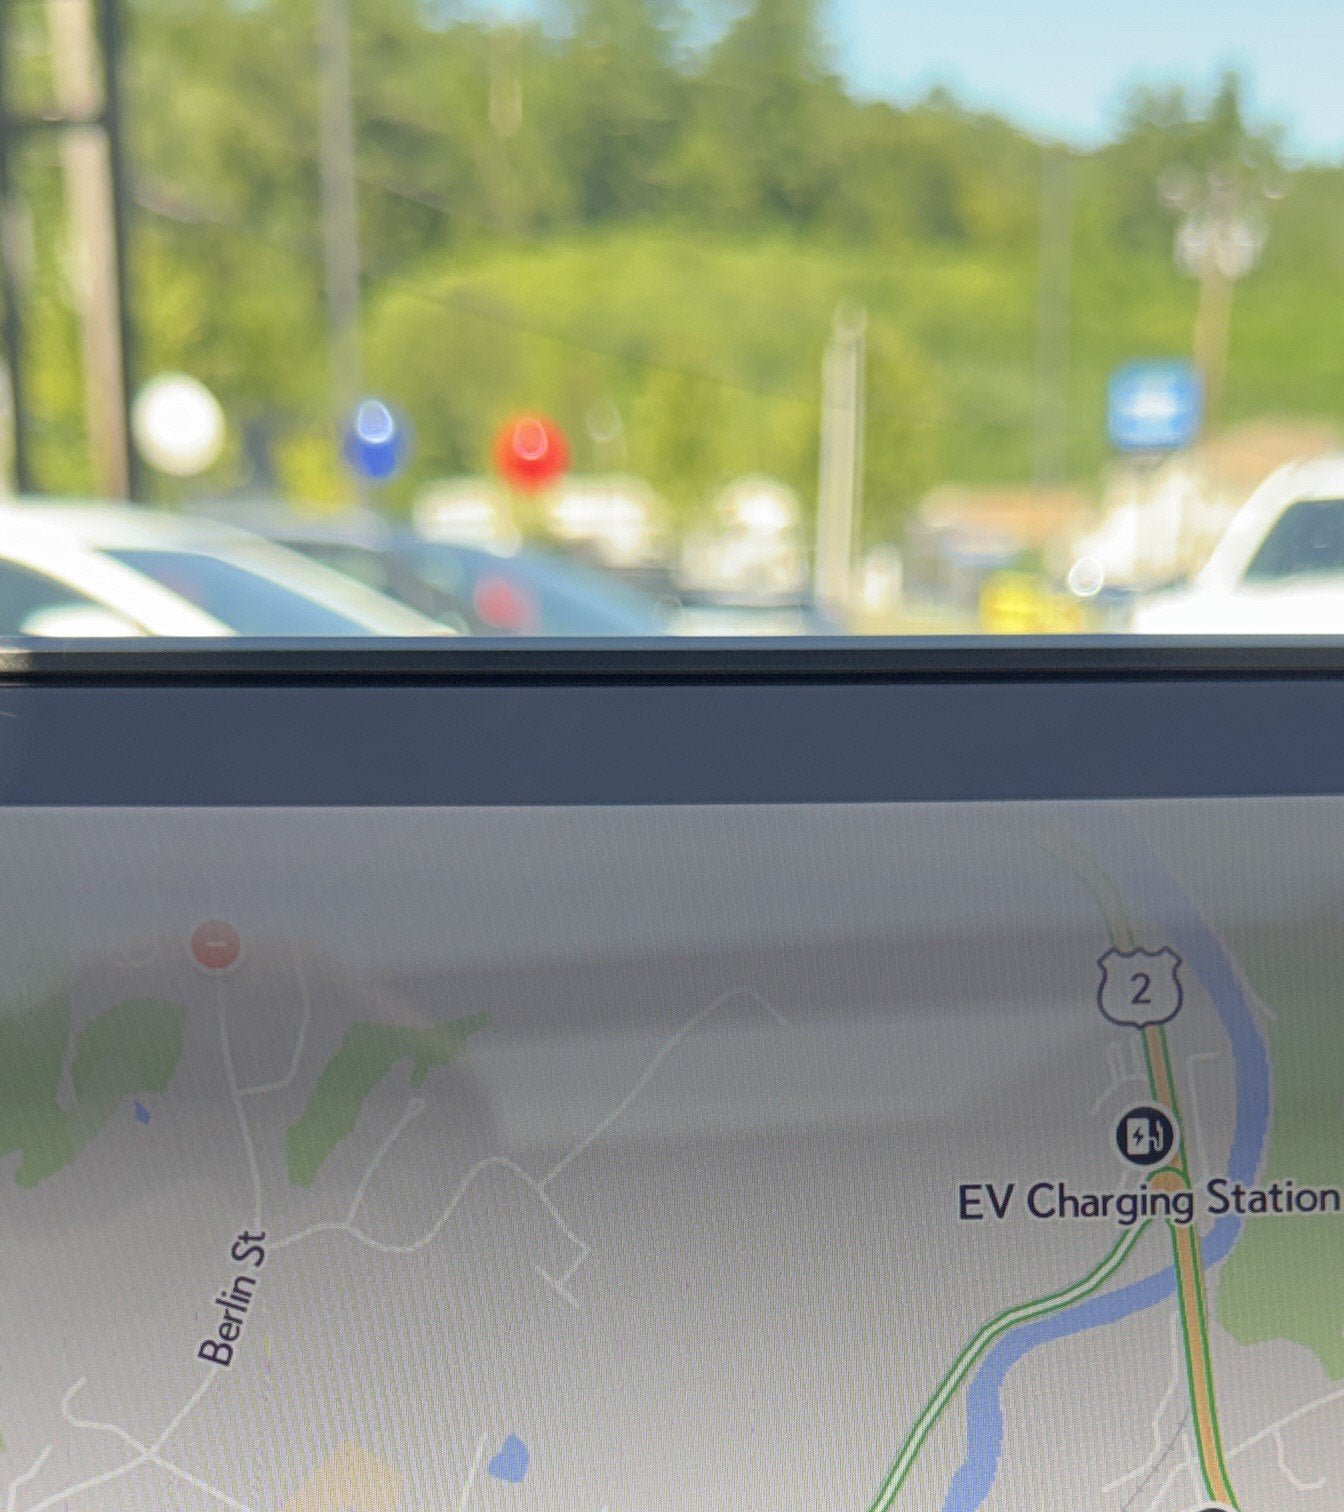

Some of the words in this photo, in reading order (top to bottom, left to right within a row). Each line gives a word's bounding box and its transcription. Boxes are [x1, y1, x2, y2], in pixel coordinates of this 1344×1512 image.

[1131, 972, 1152, 1005] 2
[959, 1183, 1015, 1220] EV
[1027, 1180, 1194, 1225] Charging
[1207, 1178, 1341, 1214] Station
[197, 1275, 256, 1367] Berlin
[231, 1230, 266, 1267] St
